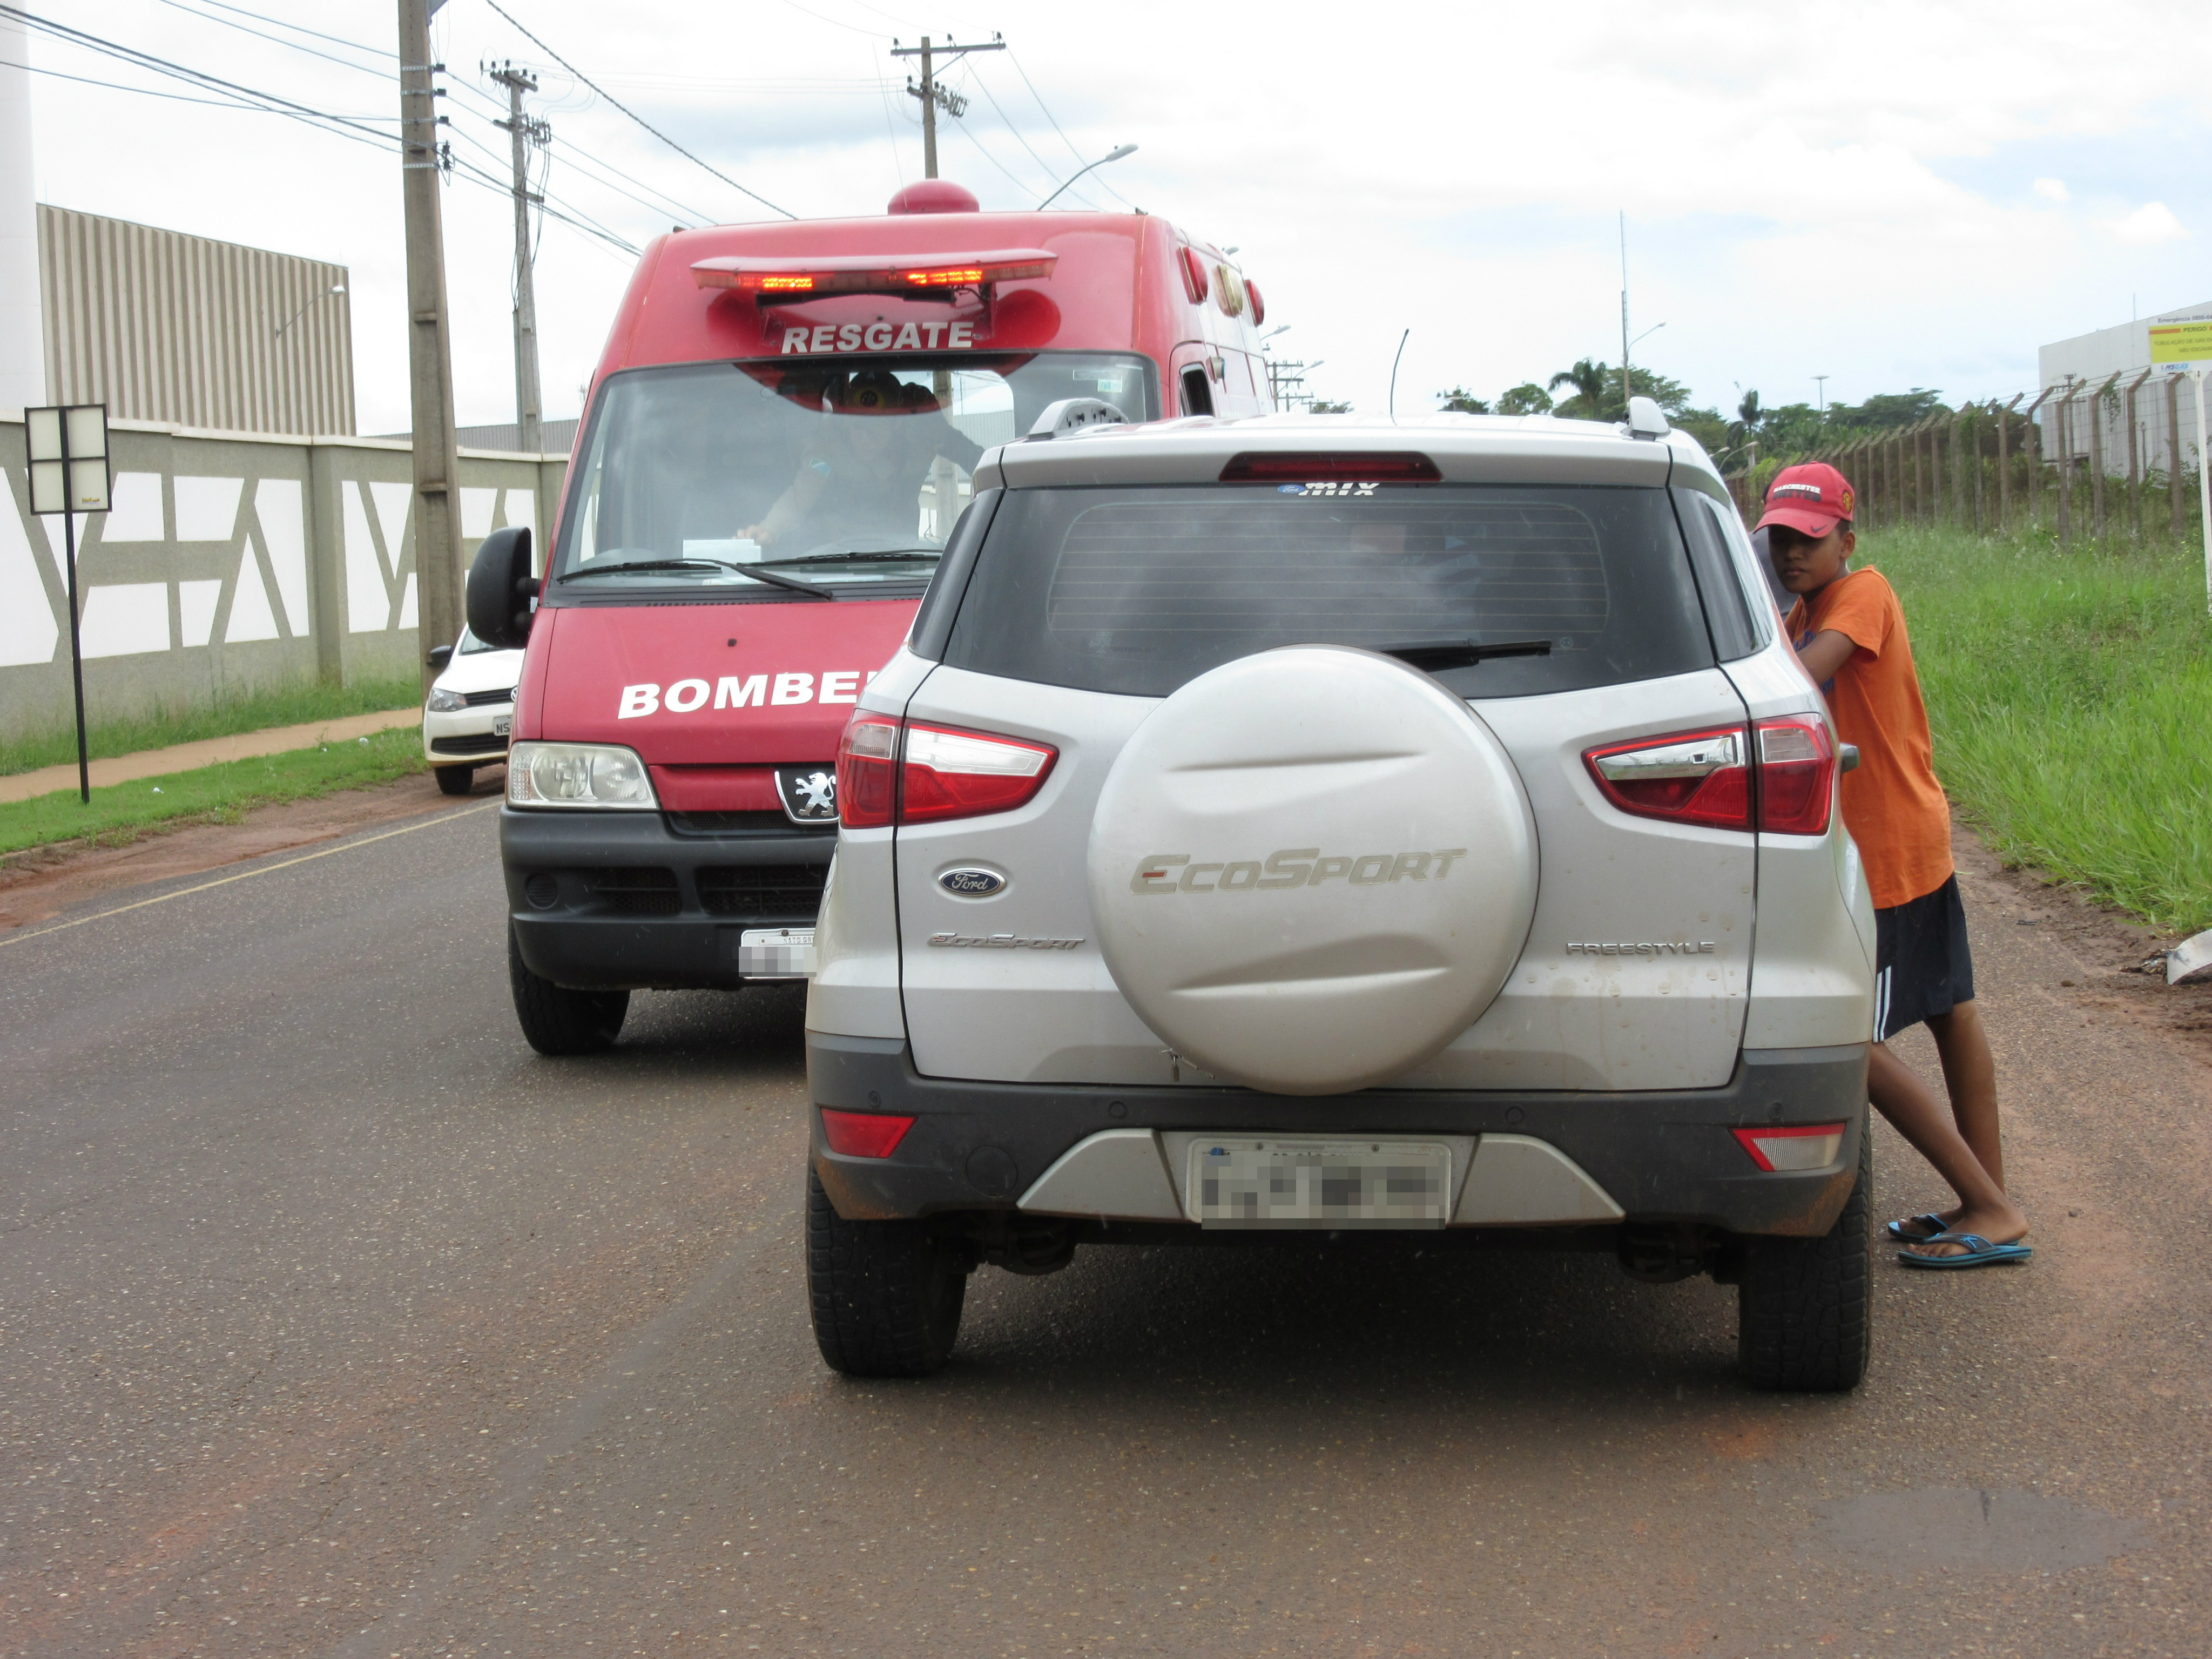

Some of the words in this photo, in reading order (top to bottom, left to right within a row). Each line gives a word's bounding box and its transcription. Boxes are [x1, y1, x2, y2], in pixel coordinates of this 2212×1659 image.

[781, 322, 974, 354] RESGATE
[1773, 483, 1820, 494] MANCHESTER
[952, 873, 988, 891] Ford
[1567, 941, 1715, 955] FREESTYLE
